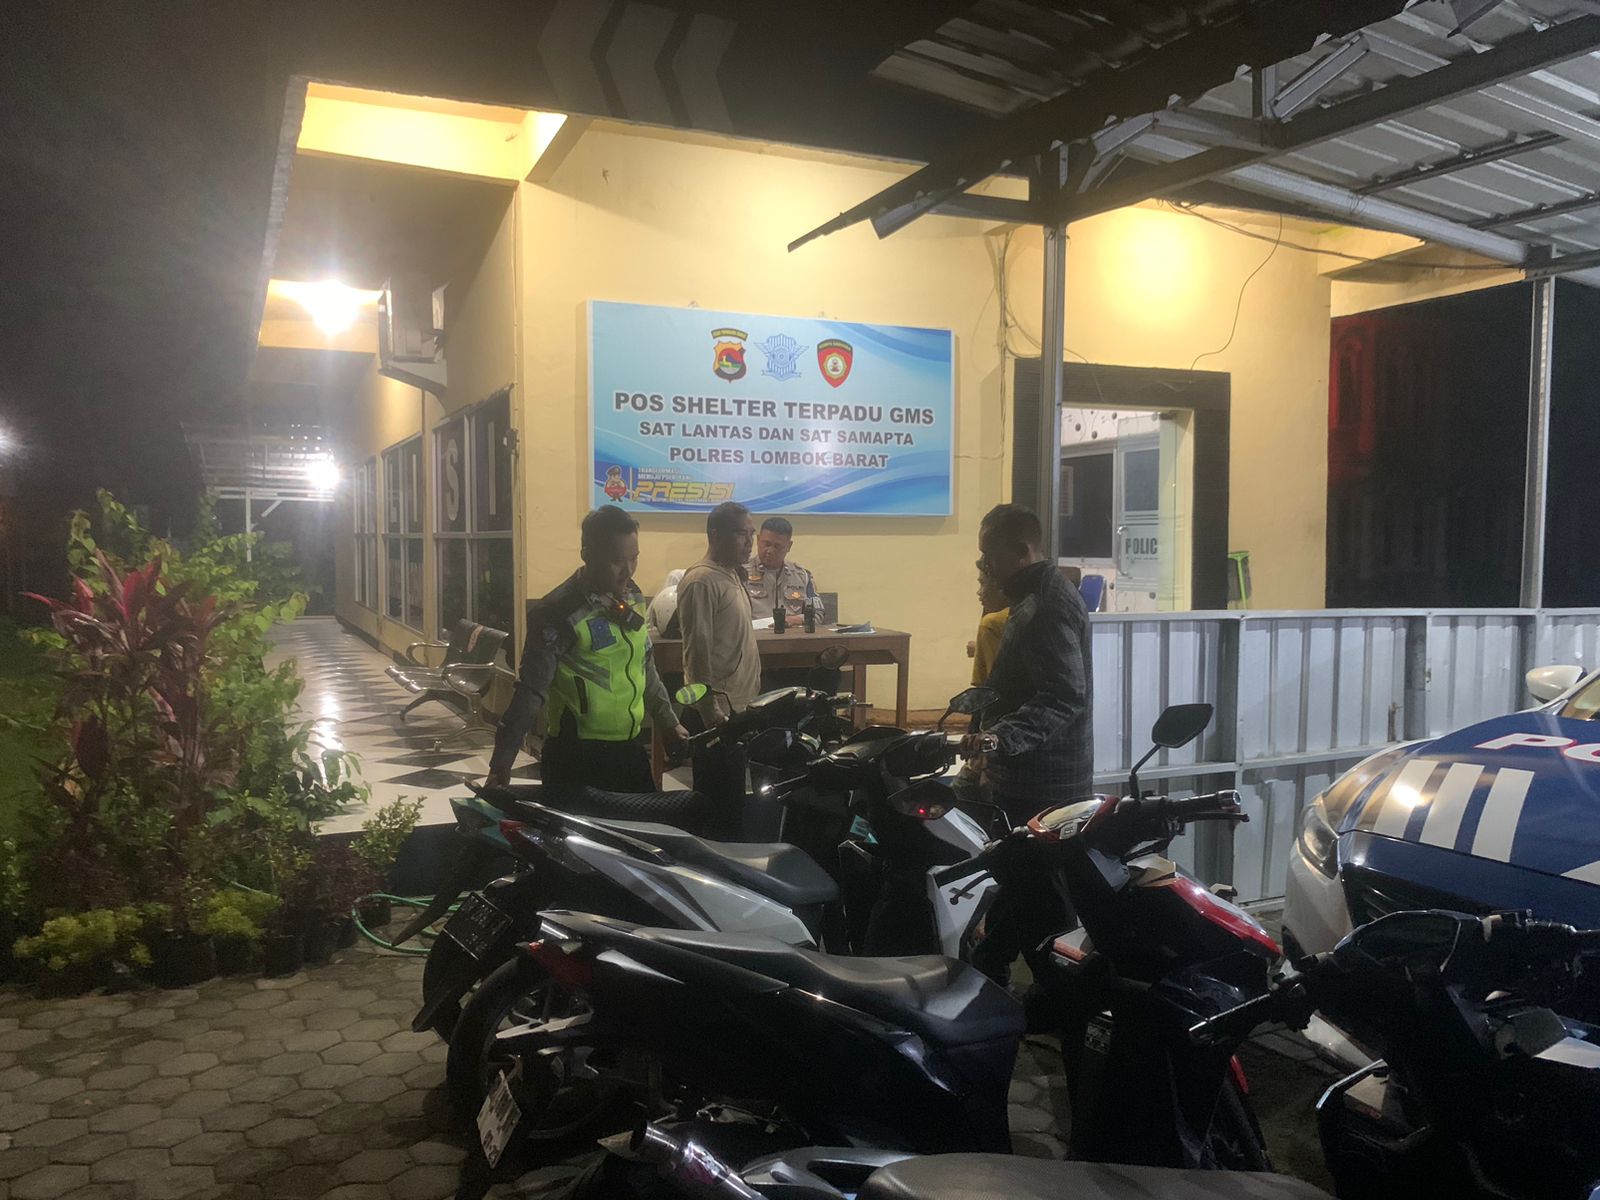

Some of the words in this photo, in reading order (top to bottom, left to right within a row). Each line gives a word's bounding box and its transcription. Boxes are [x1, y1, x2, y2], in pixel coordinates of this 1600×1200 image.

[615, 392, 664, 412] POS
[672, 395, 777, 418] SHELTER
[783, 401, 882, 422] TERPADU
[889, 407, 934, 425] GMS
[639, 421, 675, 436] SAT
[682, 423, 753, 439] LANTAS
[758, 426, 794, 441] DAN
[800, 428, 831, 443] SAT
[837, 430, 914, 445] SAMAPTA
[670, 447, 744, 463] POLRES
[750, 450, 828, 466] LOMBOK
[832, 453, 888, 468] BARAT
[634, 480, 735, 500] PRESISI
[1125, 537, 1158, 554] POLIC
